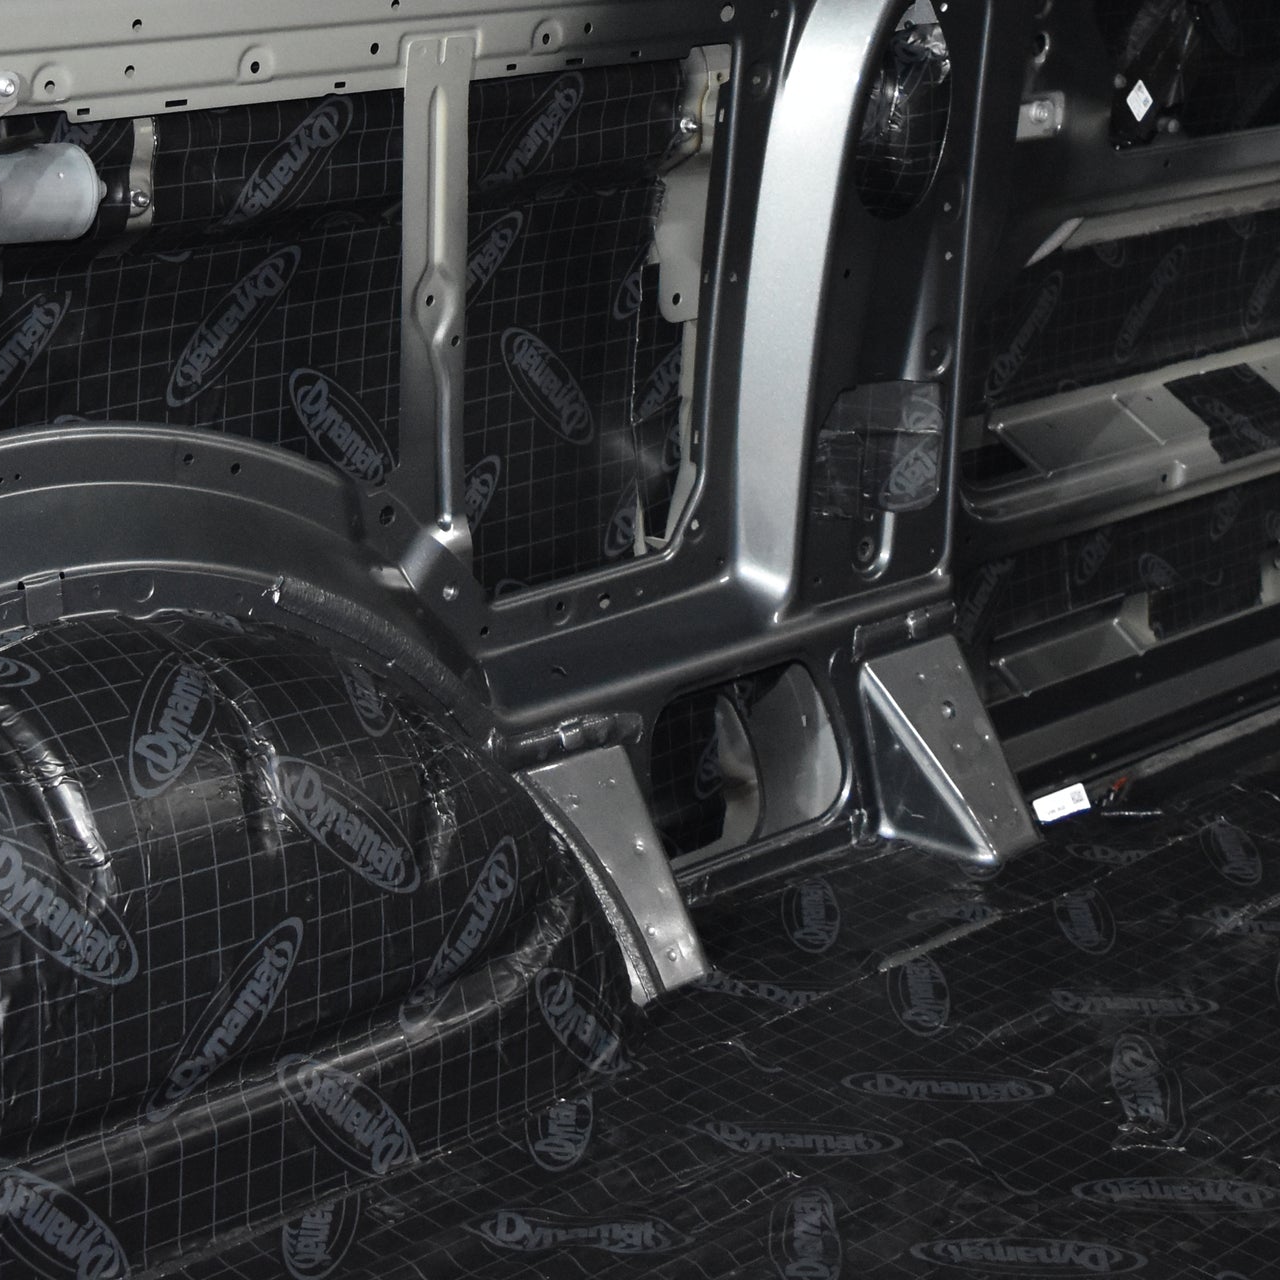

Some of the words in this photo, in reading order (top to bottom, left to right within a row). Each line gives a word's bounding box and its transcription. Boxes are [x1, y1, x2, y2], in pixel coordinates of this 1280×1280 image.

[176, 257, 286, 388] Dynamat
[514, 337, 589, 440] Dynamat
[296, 377, 386, 488] Dynamat
[292, 767, 407, 886] Dynamat
[165, 937, 294, 1100] Dynamat
[869, 1073, 1034, 1103] Dynamat
[707, 1120, 882, 1153] Dynamat
[481, 1210, 673, 1253] Dynamat
[1091, 1179, 1264, 1212] Dynamat
[936, 1236, 1124, 1273] Dynamat
